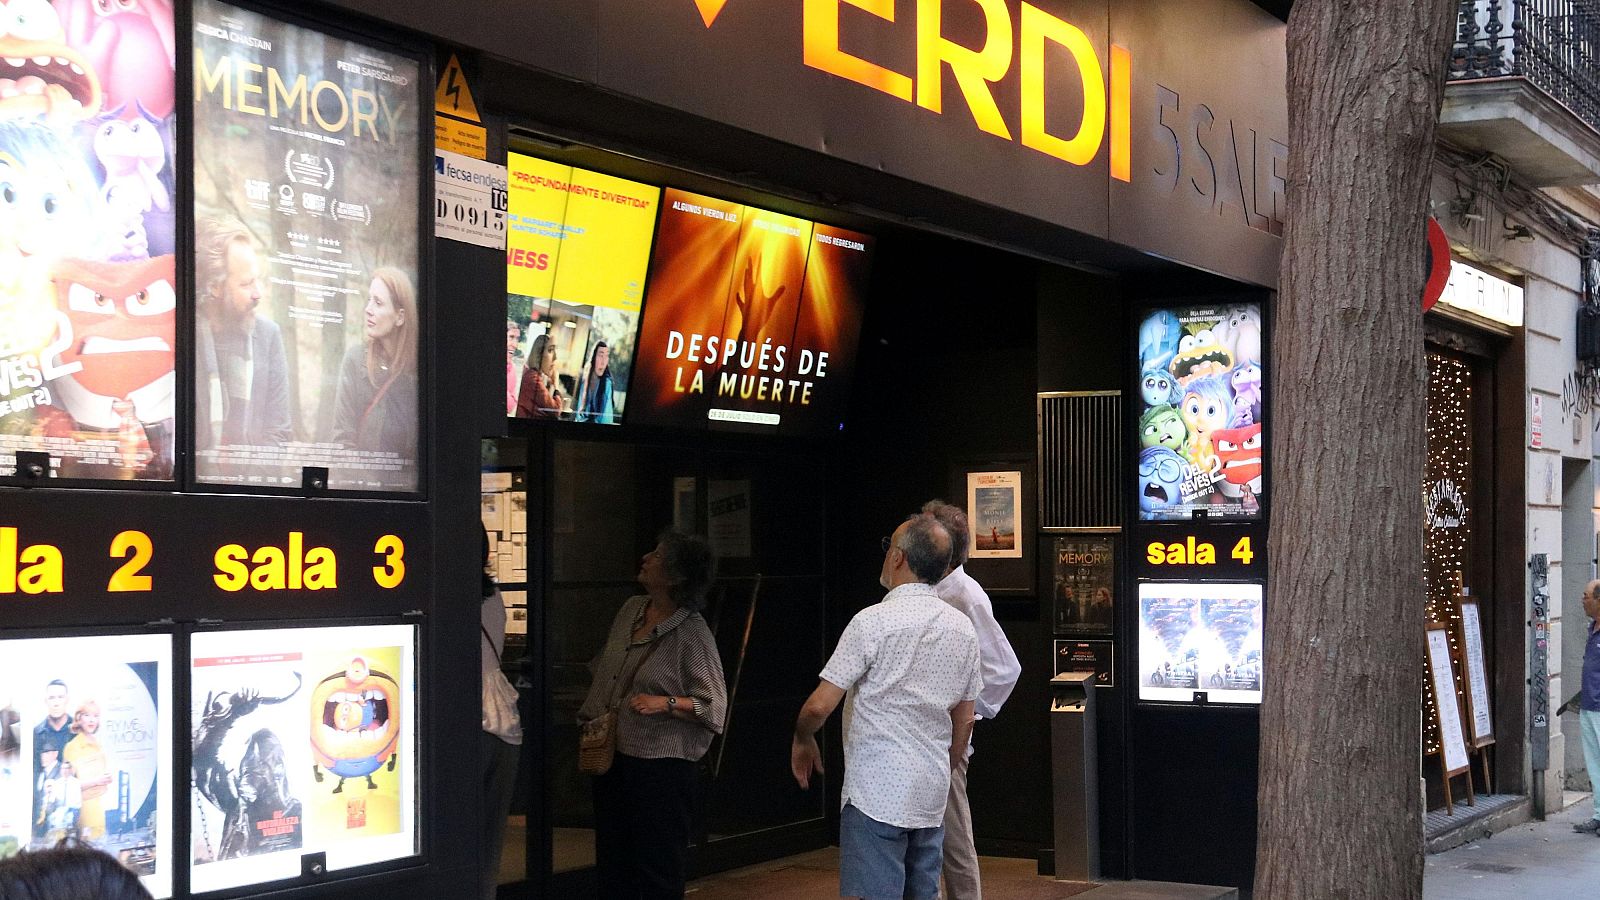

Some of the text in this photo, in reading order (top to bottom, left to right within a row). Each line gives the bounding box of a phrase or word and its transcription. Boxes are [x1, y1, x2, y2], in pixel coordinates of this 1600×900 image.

[337, 60, 360, 75] PETER
[194, 47, 405, 147] MEMORY
[695, 0, 1131, 183] ERDI
[1190, 103, 1288, 240] SALE
[437, 198, 447, 219] D
[493, 189, 508, 210] TC
[672, 201, 702, 216] ALGUNOS
[703, 206, 725, 220] VIERON
[665, 331, 829, 378] DESPUÉS DE
[674, 367, 814, 405] LA MUERTE
[1183, 454, 1227, 484] DEL 2
[0, 526, 154, 595] la 2
[213, 531, 406, 592] sala 3
[1059, 553, 1109, 565] MEMORY
[1146, 535, 1254, 565] sala 4
